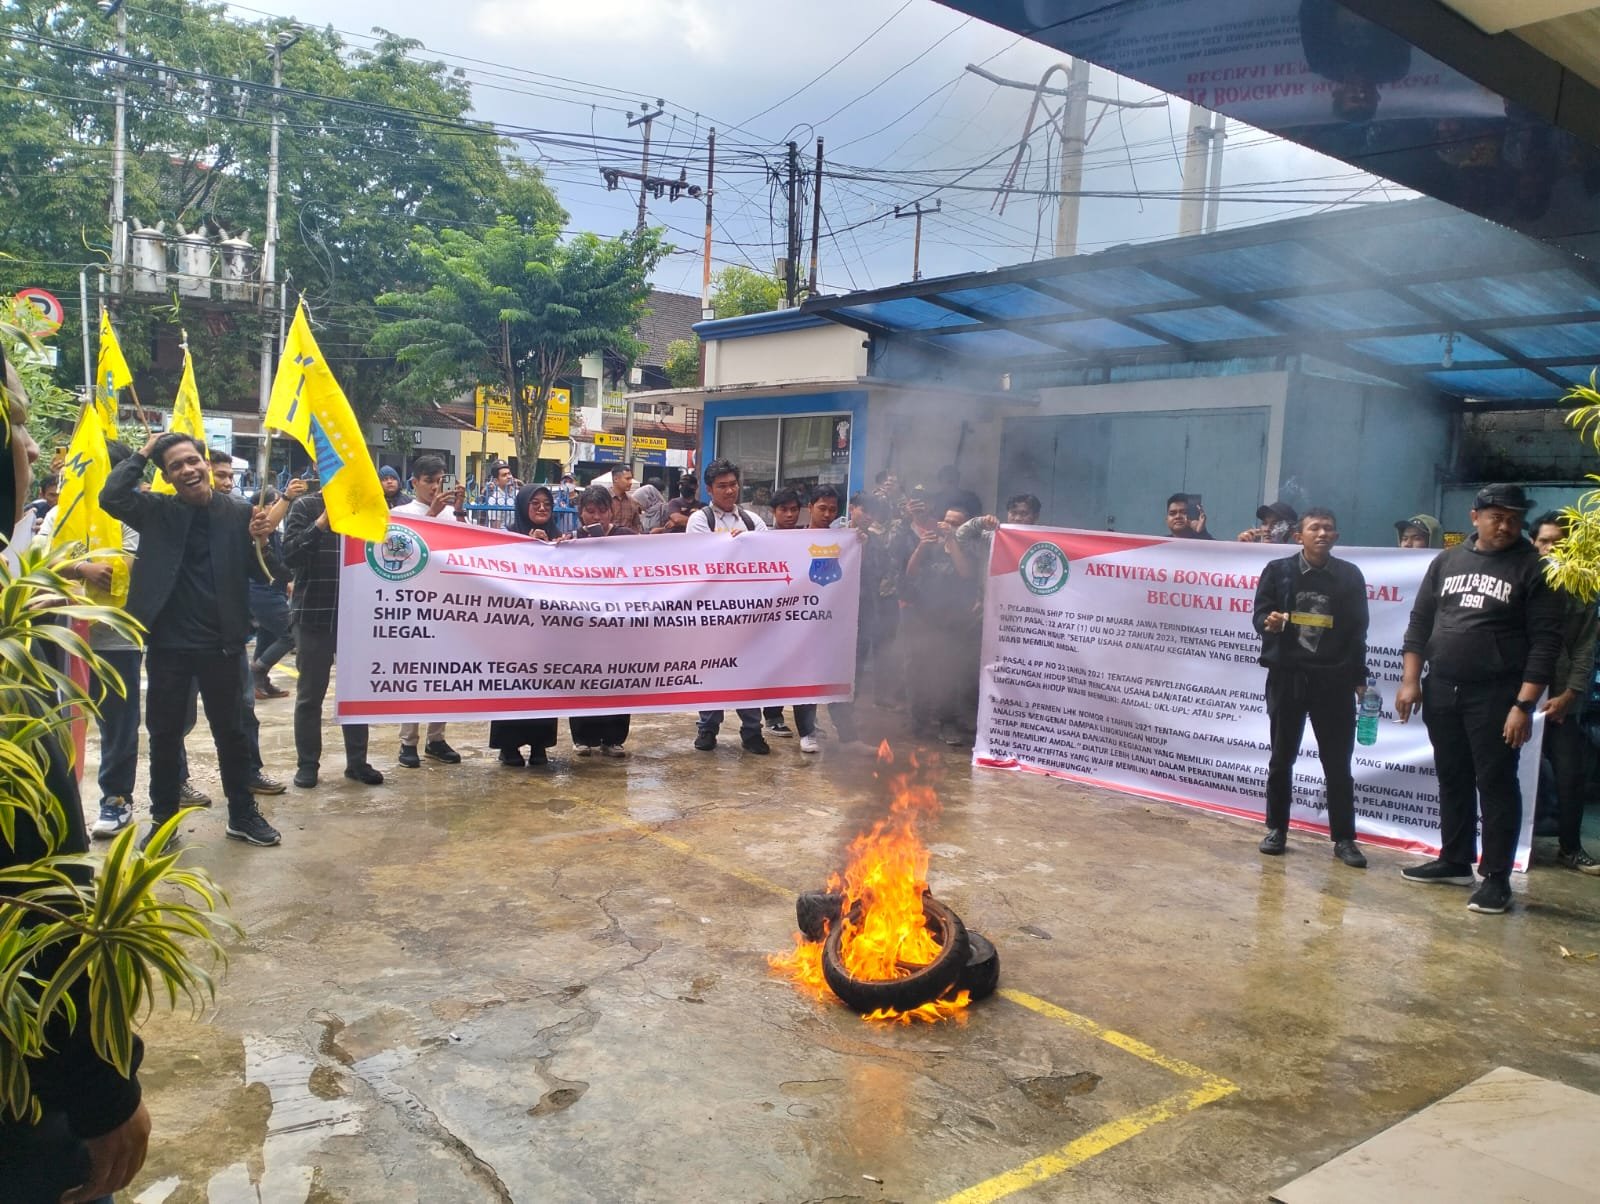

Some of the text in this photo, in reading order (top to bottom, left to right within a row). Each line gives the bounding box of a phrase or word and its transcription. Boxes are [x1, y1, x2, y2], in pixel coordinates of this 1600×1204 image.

[447, 554, 790, 579] ALIANSI MAHASISWA PESISIR BERGERAK
[1085, 562, 1404, 602] AKTIVITAS BONGKAR GAL
[1441, 573, 1512, 604] PULL&BEAR
[375, 589, 819, 612] 1. STOP ALIH MUAT BARANG DI PERAIRAN PELABUHAN SHIP TO
[1147, 590, 1222, 611] BECUKAI
[1460, 594, 1485, 608] 1991
[374, 608, 833, 628] SHIP MUARA JAWA, YANG SAAT INI MASIH BERAKTIVITAS SECARA
[1077, 613, 1094, 621] SHIP
[1096, 615, 1103, 623] DI
[1106, 617, 1134, 626] MUARA
[1136, 620, 1158, 629] JAWA
[1159, 622, 1207, 634] TERINDIKASI
[1210, 628, 1235, 637] TELAH
[373, 625, 435, 639] ILEGAL.
[999, 625, 1046, 636] LINGKUNGAN
[1098, 638, 1123, 648] USAHA
[1167, 646, 1206, 658] KEGIATAN
[1209, 651, 1231, 661] YANG
[1234, 654, 1261, 664] BERDA
[1022, 637, 1055, 648] MEMILIKI
[1057, 622, 1075, 630] AYAT
[1077, 624, 1087, 632] (1)
[1116, 629, 1126, 637] 32
[1128, 630, 1154, 640] TAHUN
[1180, 636, 1216, 647] TENTANG
[371, 657, 738, 675] 2. MENINDAK TEGAS SECARA HUKUM PARA PIHAK
[1003, 656, 1026, 666] PASAL
[1088, 670, 1104, 679] 2021
[1107, 673, 1143, 684] TENTANG
[1145, 678, 1227, 696] PENYELENGGARAAN
[1229, 690, 1266, 701] PERLIND
[370, 675, 703, 693] YANG TELAH MELAKUKAN KEGIATAN ILEGAL.
[994, 665, 1042, 678] LINGKUNGAN
[1044, 672, 1065, 681] HIDUP
[1088, 681, 1121, 692] RENCANA
[1124, 686, 1151, 697] USAHA
[1152, 691, 1193, 703] DAN/ATAU
[1196, 698, 1237, 709] KEGIATAN
[1240, 704, 1263, 713] YANG
[993, 676, 1041, 688] LINGKUNGAN
[1043, 683, 1065, 692] HIDUP
[1192, 709, 1213, 718] ATAU
[993, 707, 1026, 718] ANALISIS
[1069, 720, 1099, 731] DAMPAK
[1100, 726, 1143, 741] LINGKUNGAN
[1145, 735, 1168, 746] HIDUP
[1000, 698, 1023, 707] PASAL
[1032, 703, 1061, 713] PERMEN
[1079, 710, 1103, 722] NOMOR
[1155, 726, 1191, 738] TENTANG
[1193, 732, 1224, 744] DAFTAR
[1227, 737, 1256, 749] USAHA
[1356, 757, 1381, 768] YANG
[1385, 762, 1416, 773] WAJIB
[990, 748, 1008, 757] PADA
[1020, 722, 1055, 734] RENCANA
[1057, 729, 1080, 738] USAHA
[1119, 740, 1152, 754] KEGIATAN
[1154, 748, 1174, 759] YANG
[1176, 753, 1213, 766] MEMILIKI
[1216, 760, 1251, 773] DAMPAK
[1354, 783, 1413, 799] NGKUNGAN
[1416, 792, 1440, 803] HIDU
[990, 728, 1010, 736] WAJIB
[1012, 731, 1048, 743] MEMILIKI
[1082, 744, 1108, 754] DIATUR
[1110, 749, 1129, 759] LEBIH
[1132, 754, 1156, 765] LANJUT
[1159, 761, 1185, 772] DALAM
[1188, 767, 1234, 782] PERATURAN
[1237, 776, 1265, 787] MENTE
[1292, 785, 1320, 797] SEBUT
[1362, 797, 1423, 813] PELABUHAN
[990, 738, 1010, 747] SALAH
[1013, 742, 1031, 751] SATU
[1033, 746, 1068, 758] AKTIFITAS
[1070, 753, 1089, 763] YANG
[1092, 756, 1113, 767] WAJIB
[1116, 761, 1148, 774] MEMILIKI
[1150, 770, 1177, 782] AMDAL
[1179, 776, 1238, 793] SEBAGAIMANA
[1296, 798, 1328, 810] DALAM
[1354, 808, 1383, 819] PIRAN
